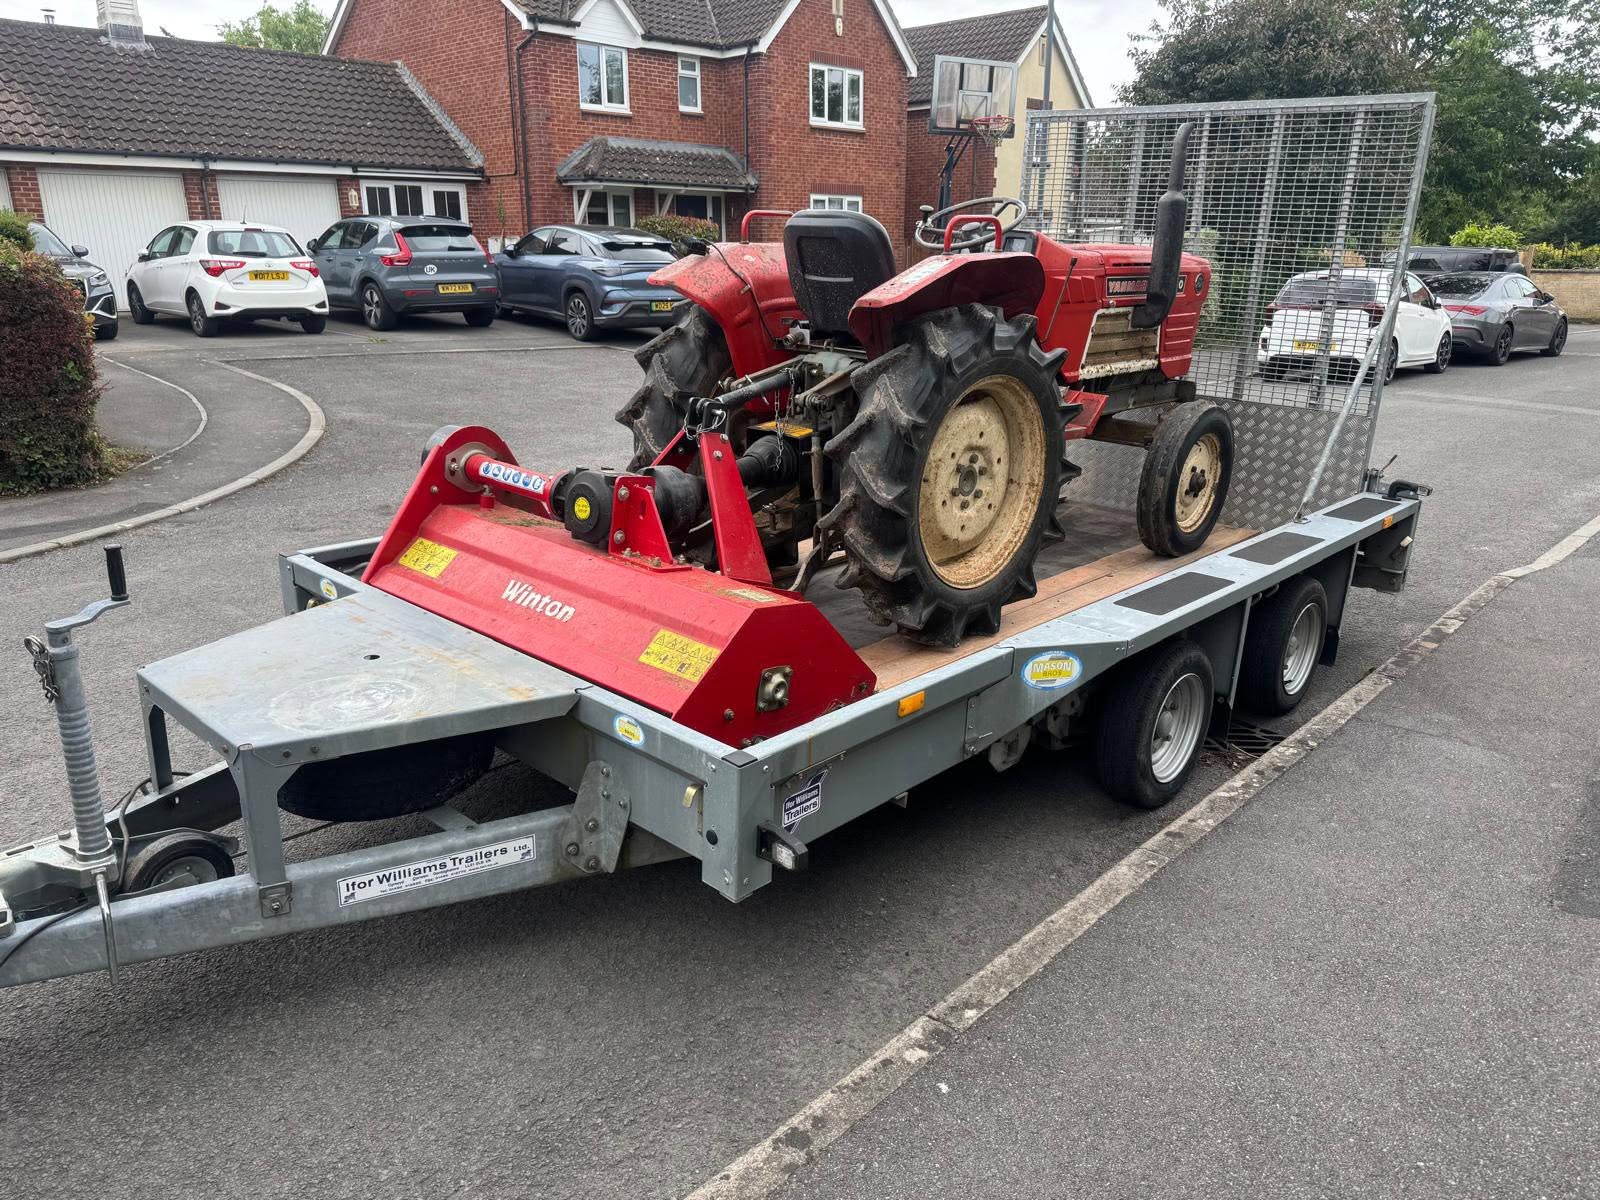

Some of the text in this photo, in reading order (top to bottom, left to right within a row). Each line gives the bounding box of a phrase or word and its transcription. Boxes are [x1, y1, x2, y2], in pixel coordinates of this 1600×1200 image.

[425, 265, 436, 274] UK
[501, 579, 576, 623] Winton
[1033, 661, 1072, 672] MASON
[1042, 669, 1063, 677] BROS
[785, 800, 818, 821] Trailers
[345, 878, 374, 892] Ifor
[376, 861, 447, 885] Williams
[450, 846, 508, 867] Trailers
[513, 843, 530, 852] Ltd.
